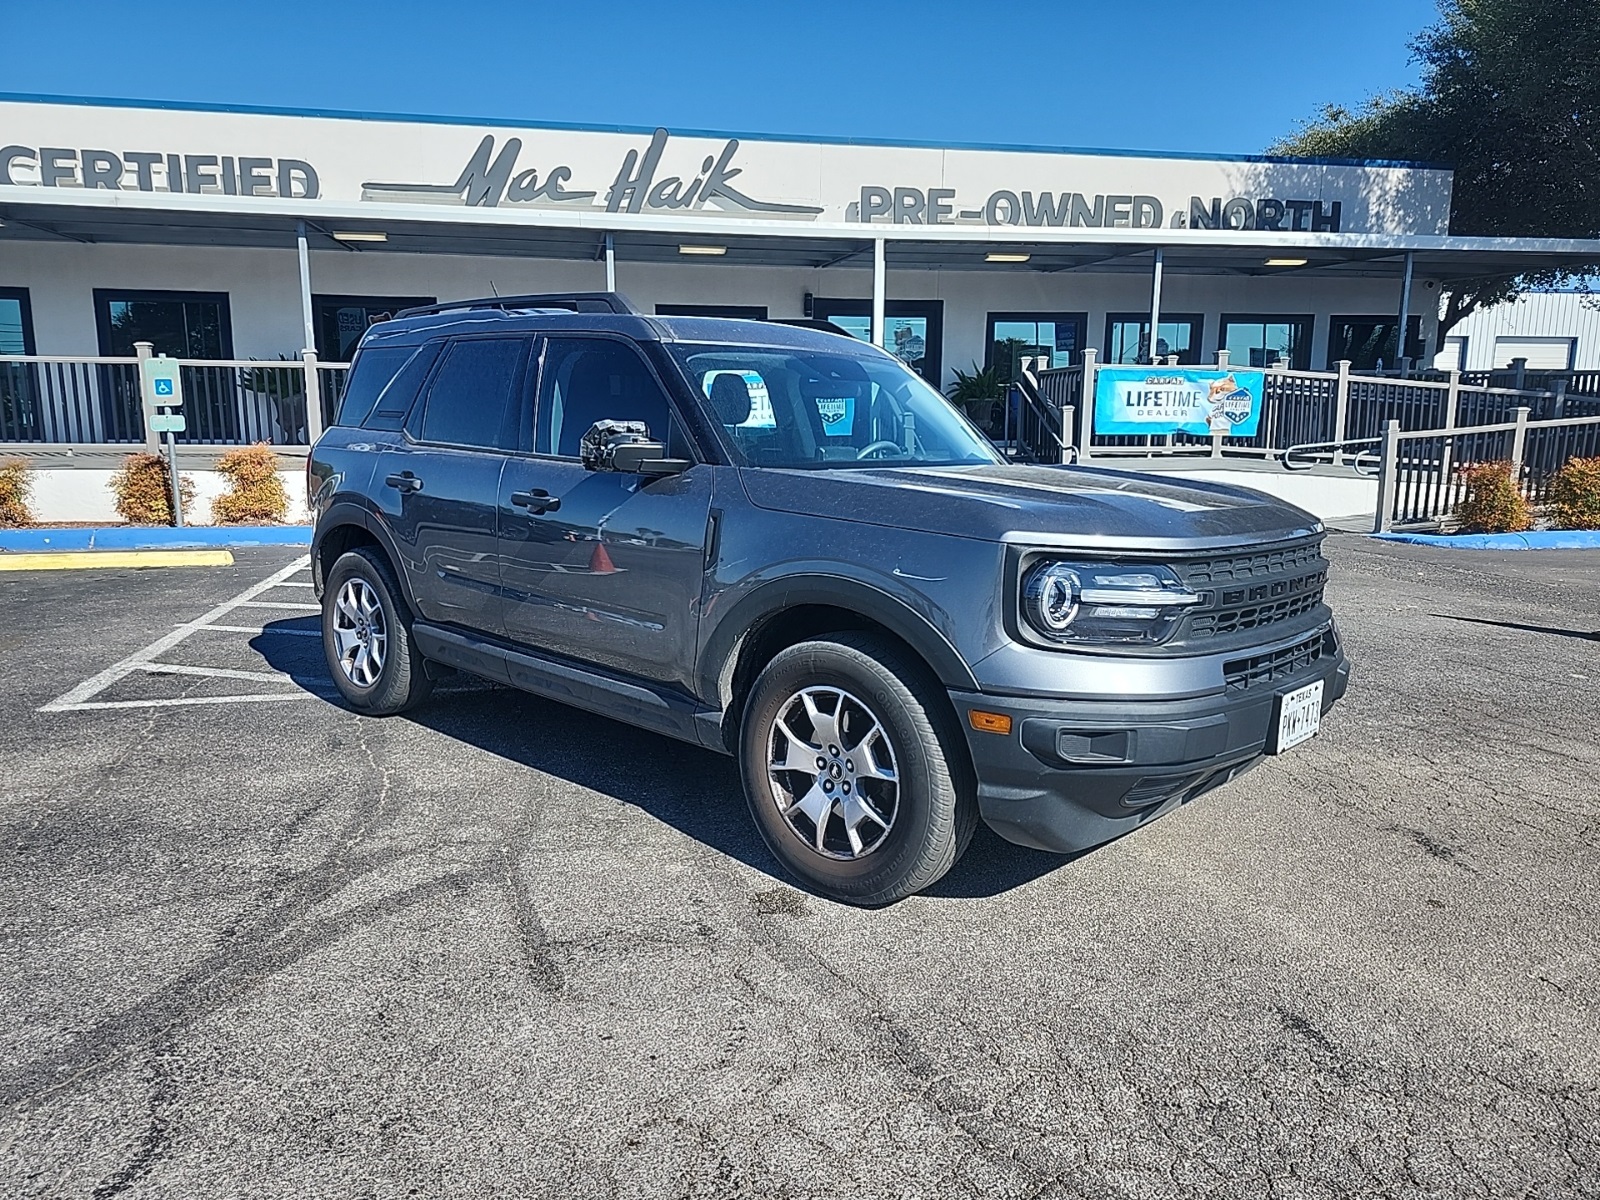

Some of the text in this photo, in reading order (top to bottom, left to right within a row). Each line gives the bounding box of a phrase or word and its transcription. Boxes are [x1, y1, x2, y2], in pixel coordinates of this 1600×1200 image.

[0, 144, 320, 200] CERTIFIED
[361, 127, 824, 214] Mac Haik
[860, 185, 1342, 233] PRE-OWNED NORTH
[1145, 376, 1185, 386] CARFAX
[1126, 390, 1202, 408] LIFETIME
[1137, 409, 1188, 417] DEALER
[1222, 569, 1328, 606] BRONCO
[1296, 688, 1312, 704] TEXAS
